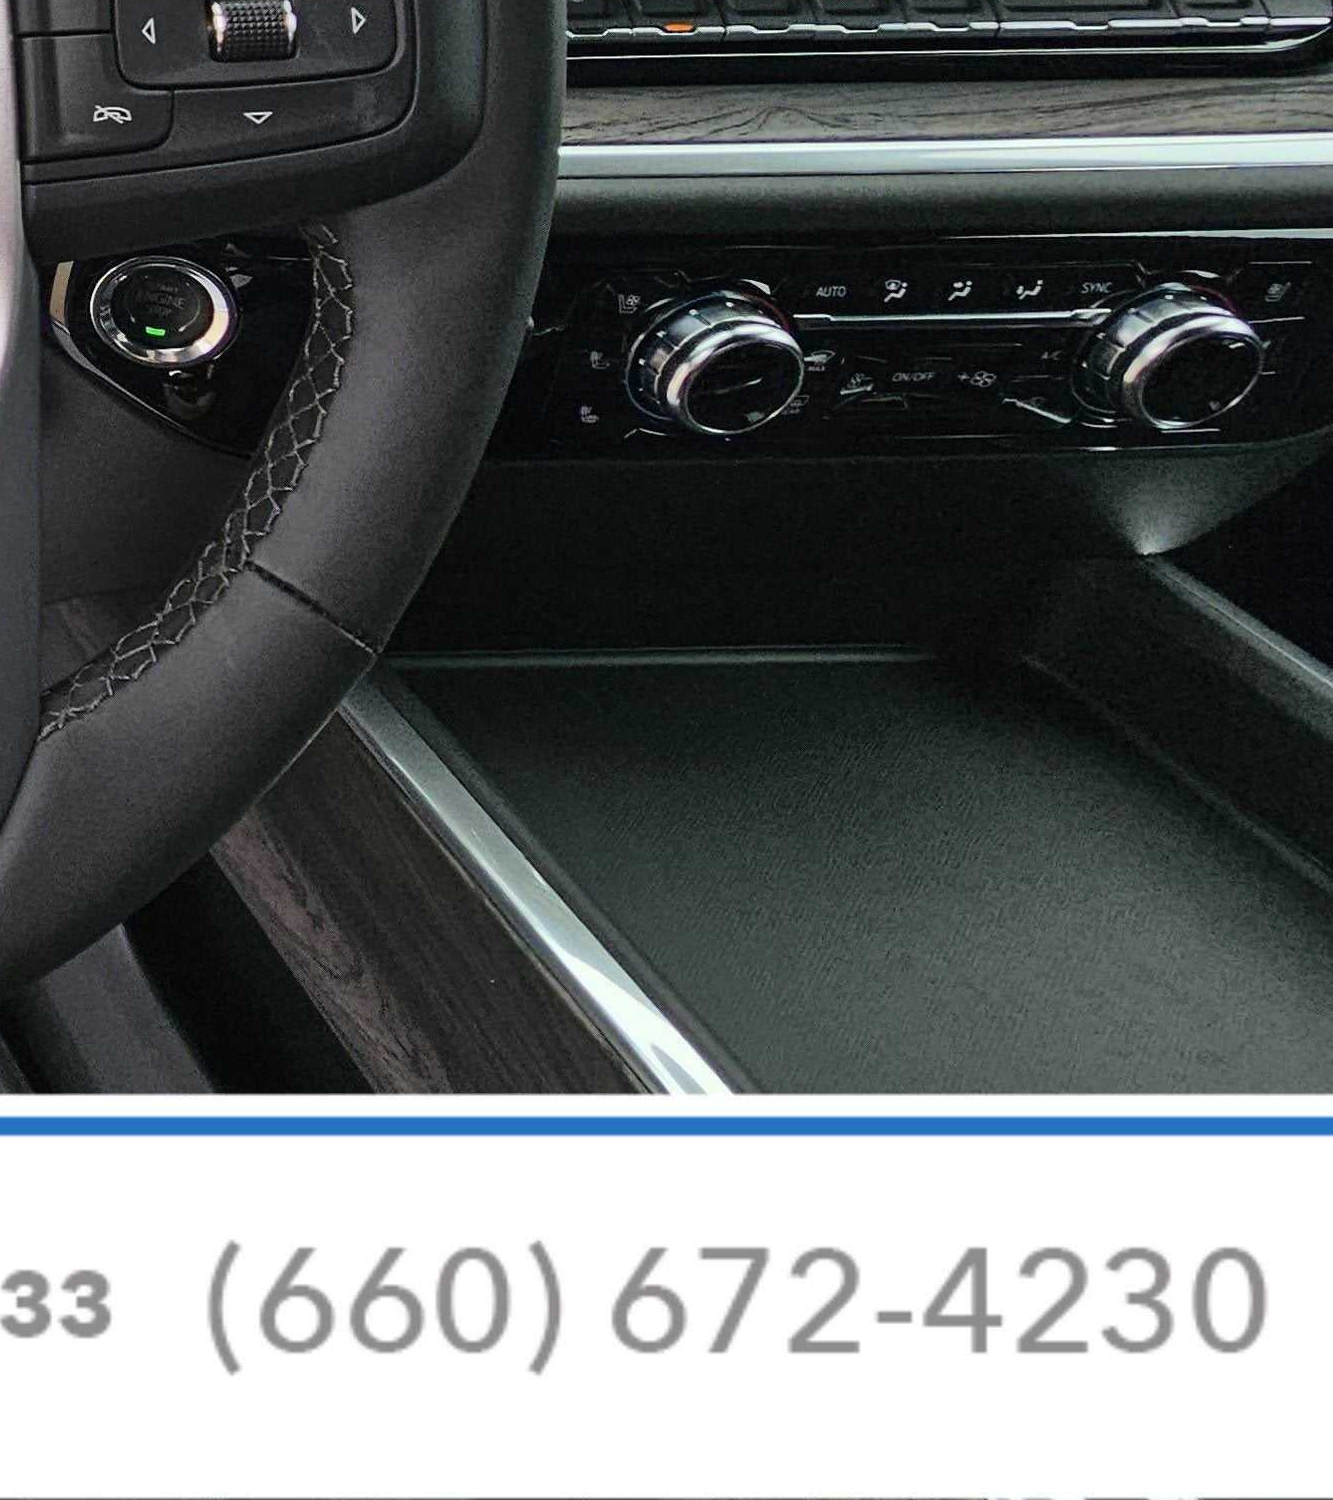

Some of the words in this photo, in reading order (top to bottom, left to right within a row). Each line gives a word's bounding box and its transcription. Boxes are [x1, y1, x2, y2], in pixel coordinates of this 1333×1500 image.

[815, 285, 847, 298] AUTO
[1081, 282, 1113, 295] SYNC
[892, 371, 935, 383] ON/OFF
